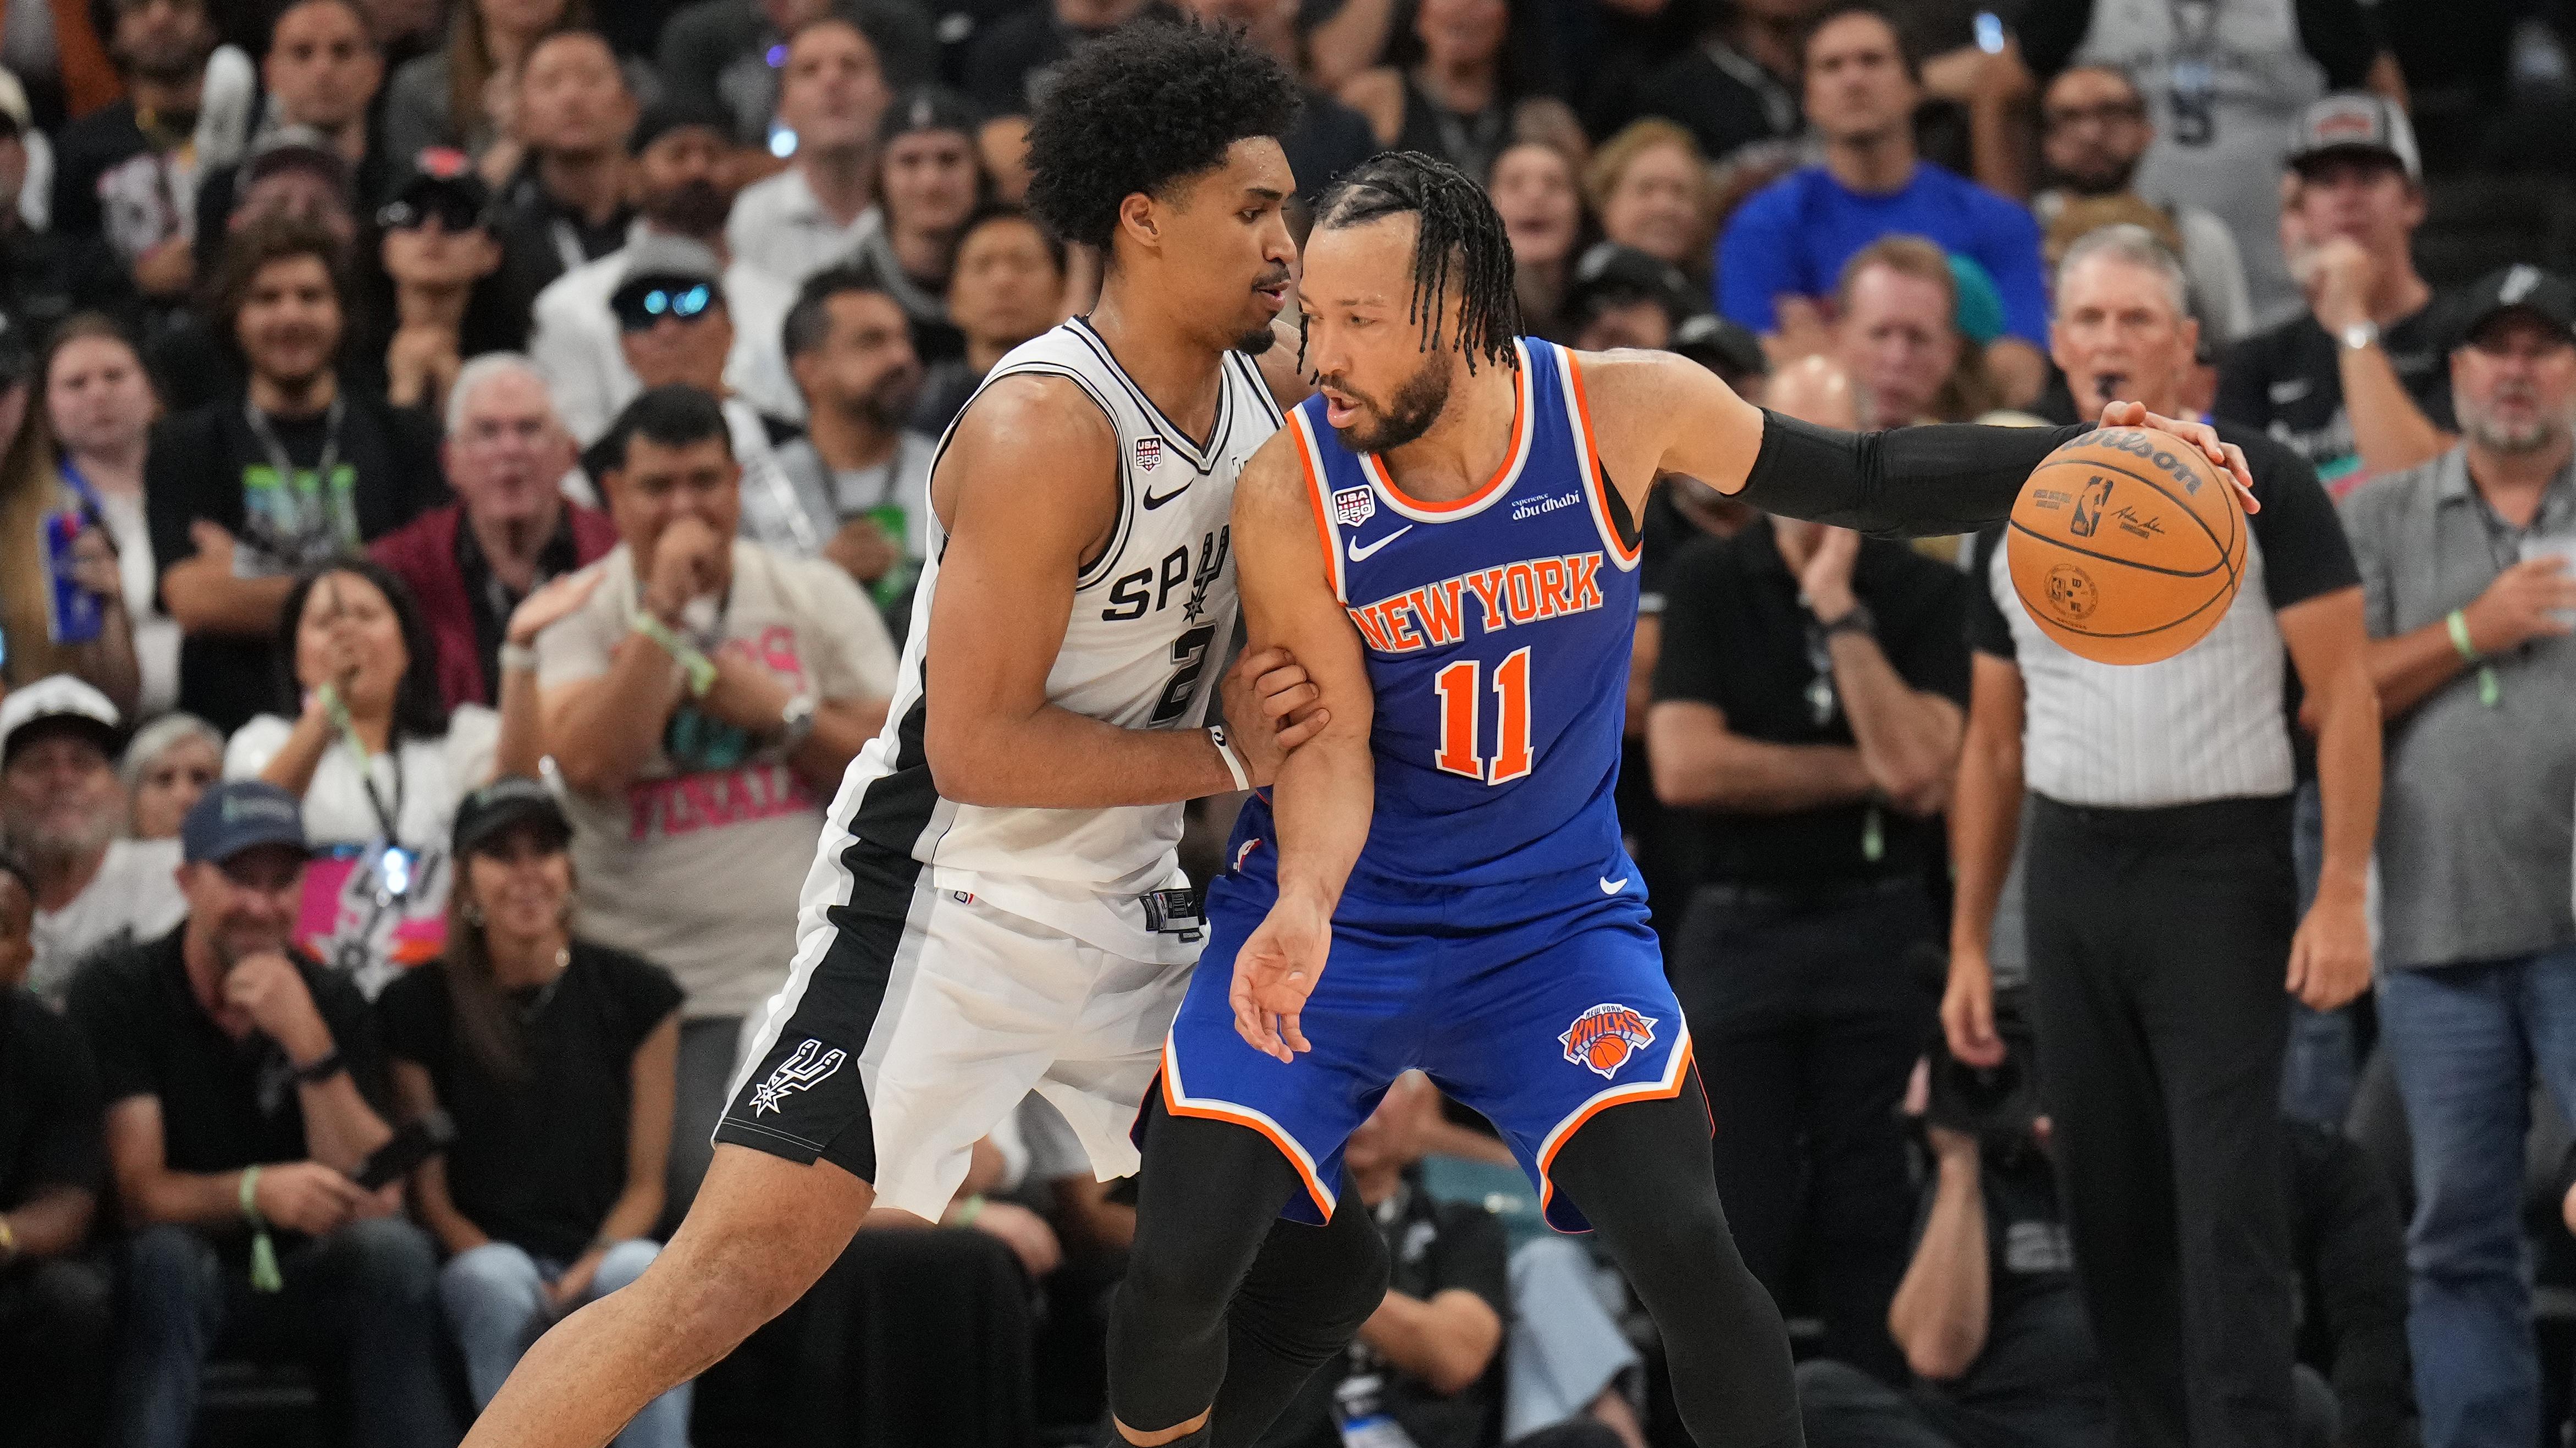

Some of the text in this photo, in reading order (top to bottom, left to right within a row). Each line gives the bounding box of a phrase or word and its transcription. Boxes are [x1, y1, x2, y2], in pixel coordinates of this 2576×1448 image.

[1138, 441, 1159, 450] USA
[1137, 454, 1161, 466] 250
[1337, 491, 1368, 504] USA
[1512, 493, 1548, 506] experience
[1513, 490, 1580, 520] abu dhabi
[1339, 504, 1372, 520] 250
[1102, 524, 1229, 625] SPU
[1346, 550, 1603, 653] NEW YORK
[1148, 620, 1217, 727] 2
[1435, 645, 1535, 786] 11
[1586, 1007, 1601, 1018] NEW
[1567, 1010, 1651, 1057] KNICKS
